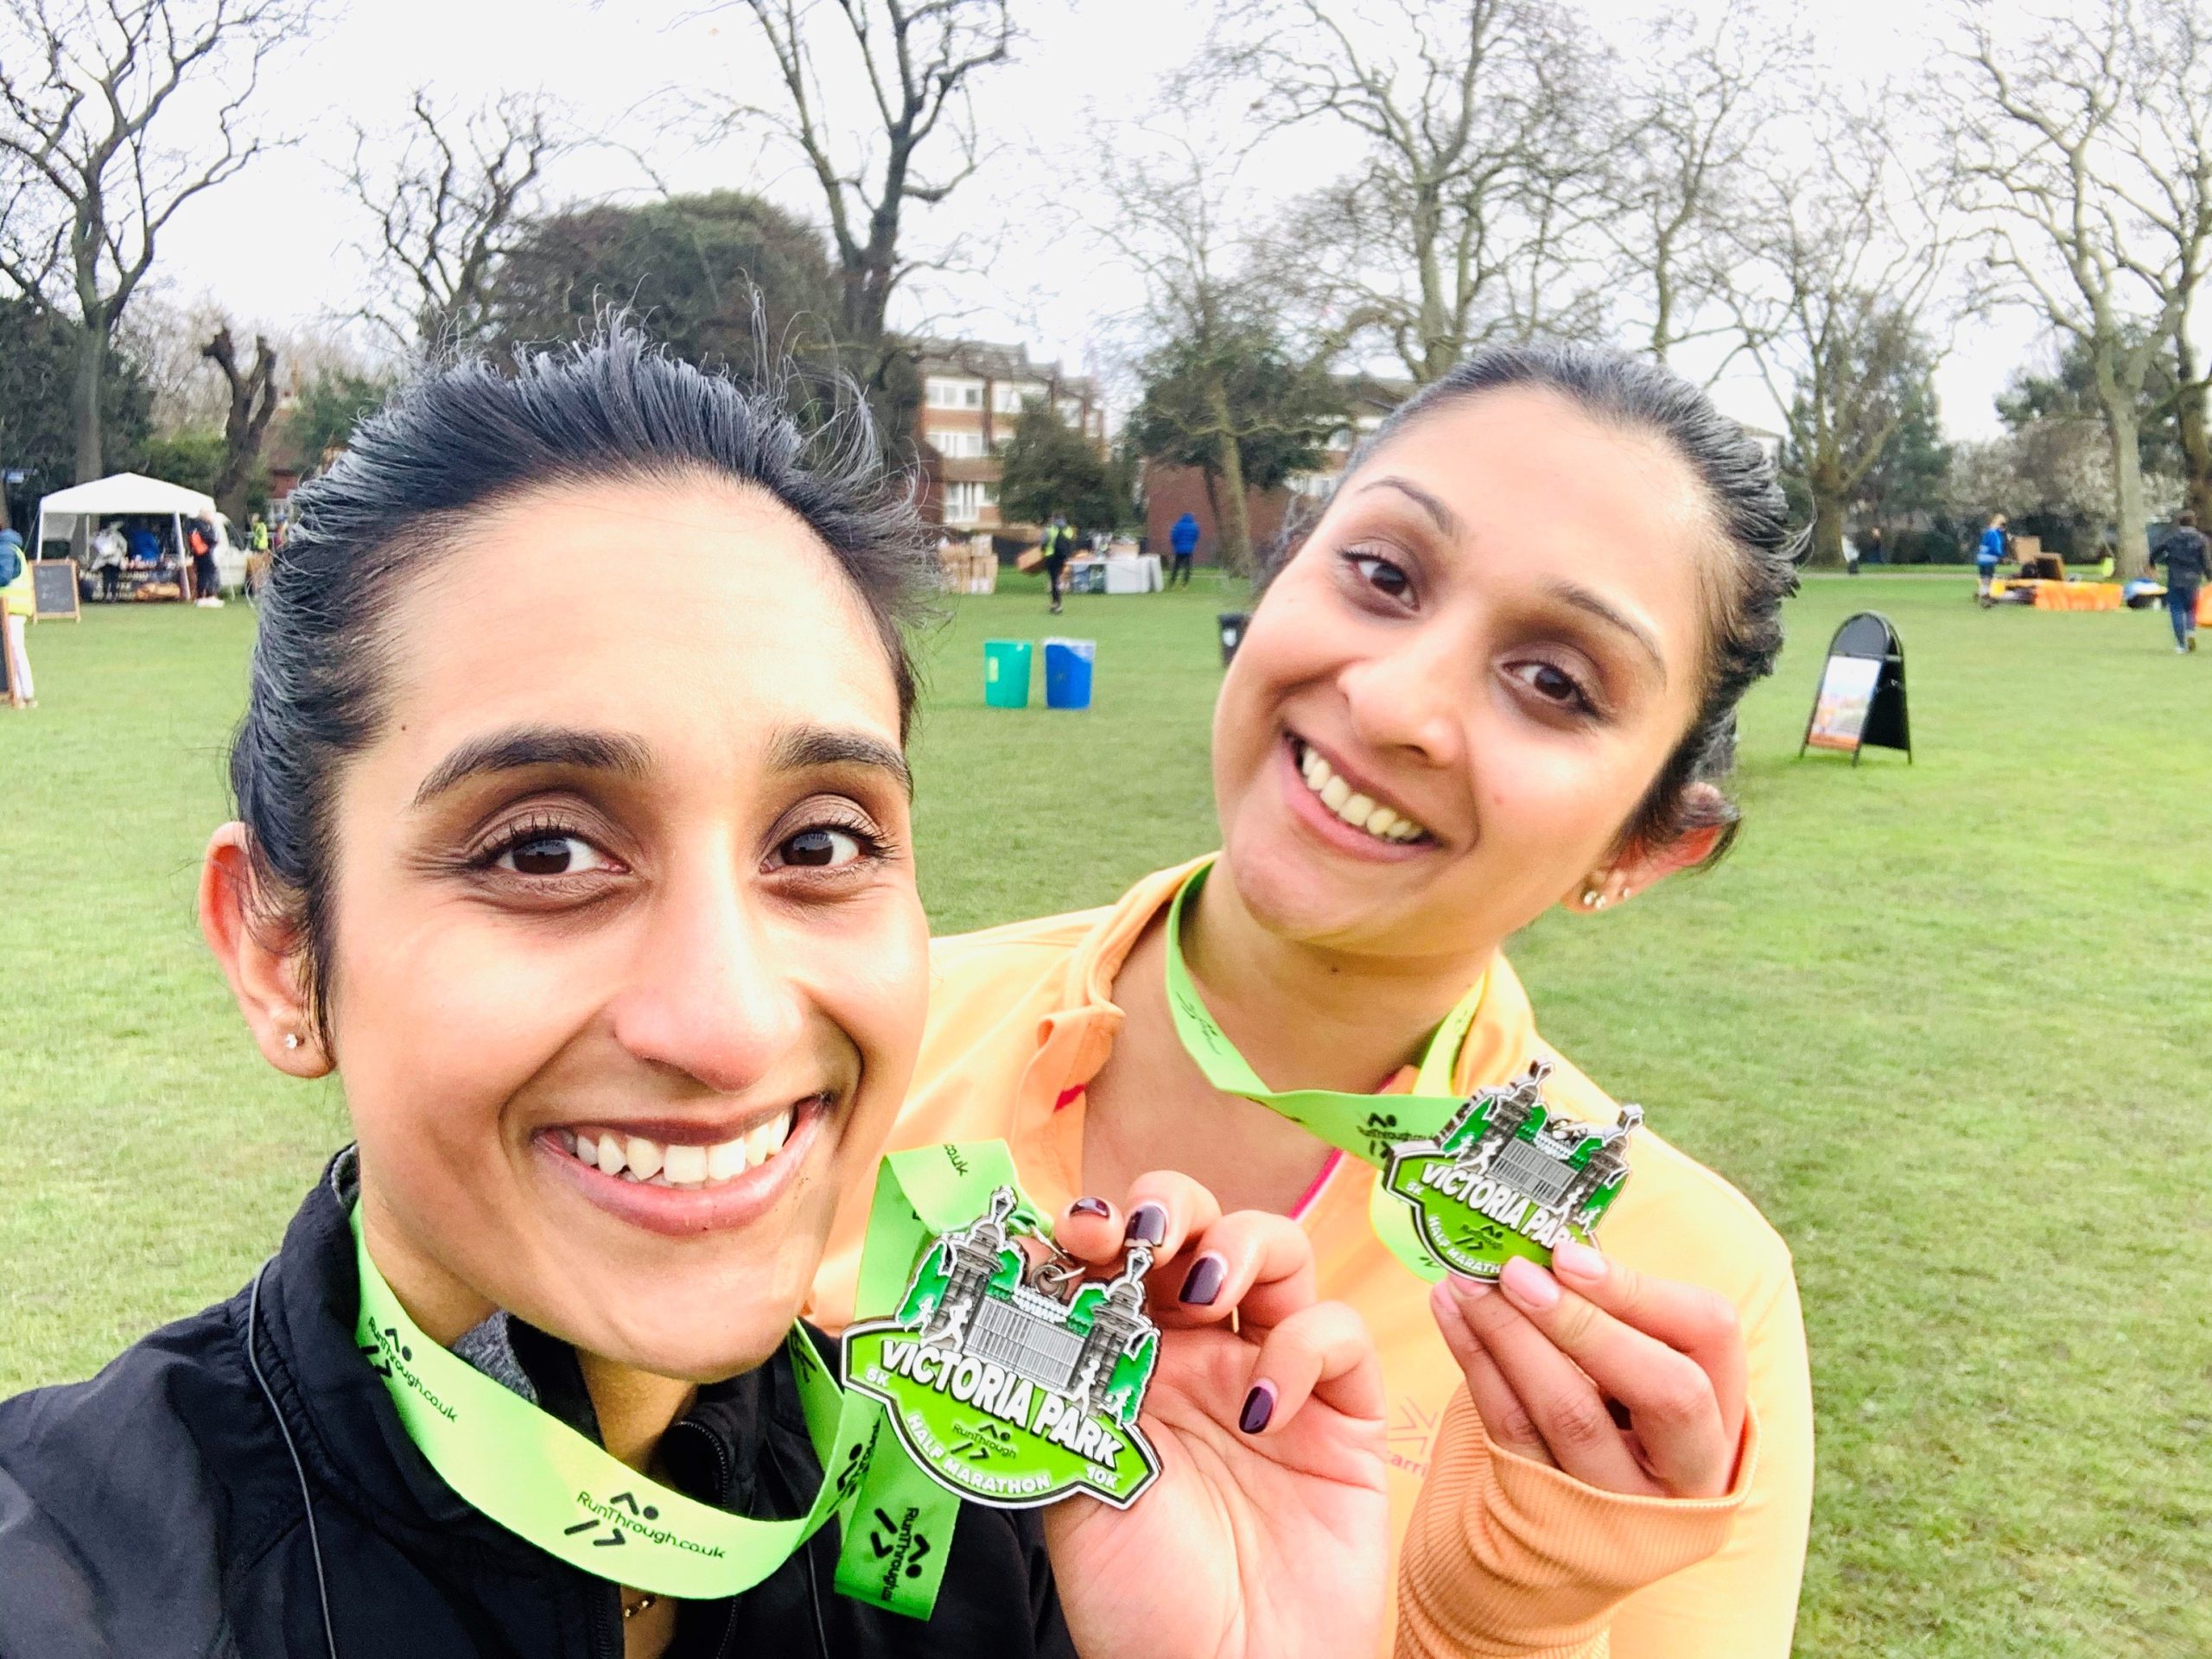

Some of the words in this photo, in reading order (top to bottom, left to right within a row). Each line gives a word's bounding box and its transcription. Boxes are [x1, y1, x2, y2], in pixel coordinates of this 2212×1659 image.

[1405, 1181, 1425, 1197] 5K
[1421, 1162, 1531, 1230] VICTORIA
[1520, 1205, 1576, 1249] PAR
[1427, 1215, 1451, 1248] HALF
[1446, 1247, 1501, 1274] MARATH
[368, 1316, 458, 1422] RunThrough.co.uk
[865, 1367, 890, 1387] 5K
[880, 1340, 1037, 1430] VICTORIA
[1032, 1392, 1126, 1471] PARK
[906, 1413, 944, 1460] HALF
[942, 1456, 1051, 1495] MARATHON
[952, 1423, 1017, 1459] RunThrough
[1084, 1465, 1117, 1490] 10K
[576, 1491, 726, 1559] RunThrough.co.uk
